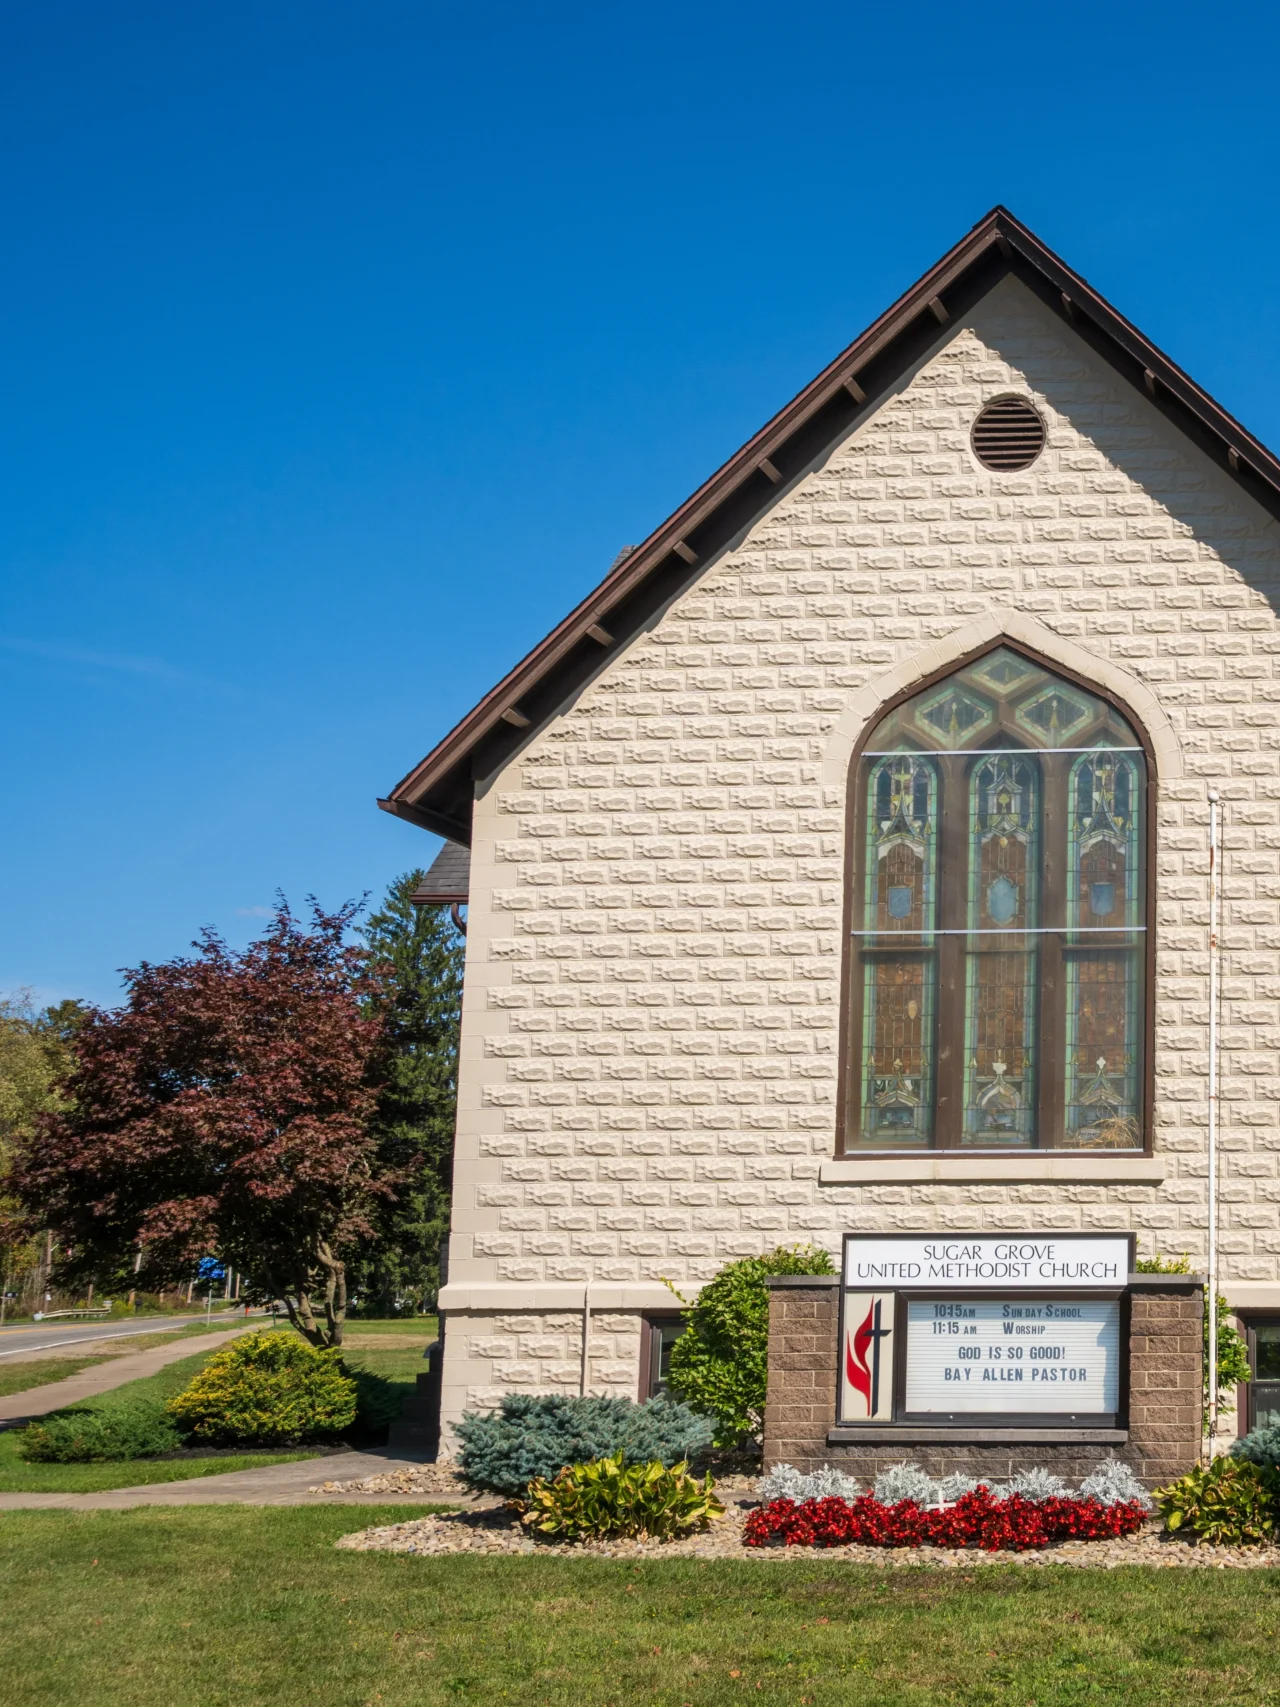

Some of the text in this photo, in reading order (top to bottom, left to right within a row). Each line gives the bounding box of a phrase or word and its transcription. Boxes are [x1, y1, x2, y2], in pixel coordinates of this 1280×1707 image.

[923, 1244, 1055, 1261] SUGAR GROVE
[857, 1262, 1117, 1279] UNITED METHODIST CHURCH
[1045, 1303, 1082, 1318] SCHOOL
[932, 1321, 1046, 1335] 11:15 AM WORSHIP
[958, 1346, 1066, 1360] GOD IS SO GOOD!
[944, 1367, 1087, 1381] BAY ALLEN PASTOR
